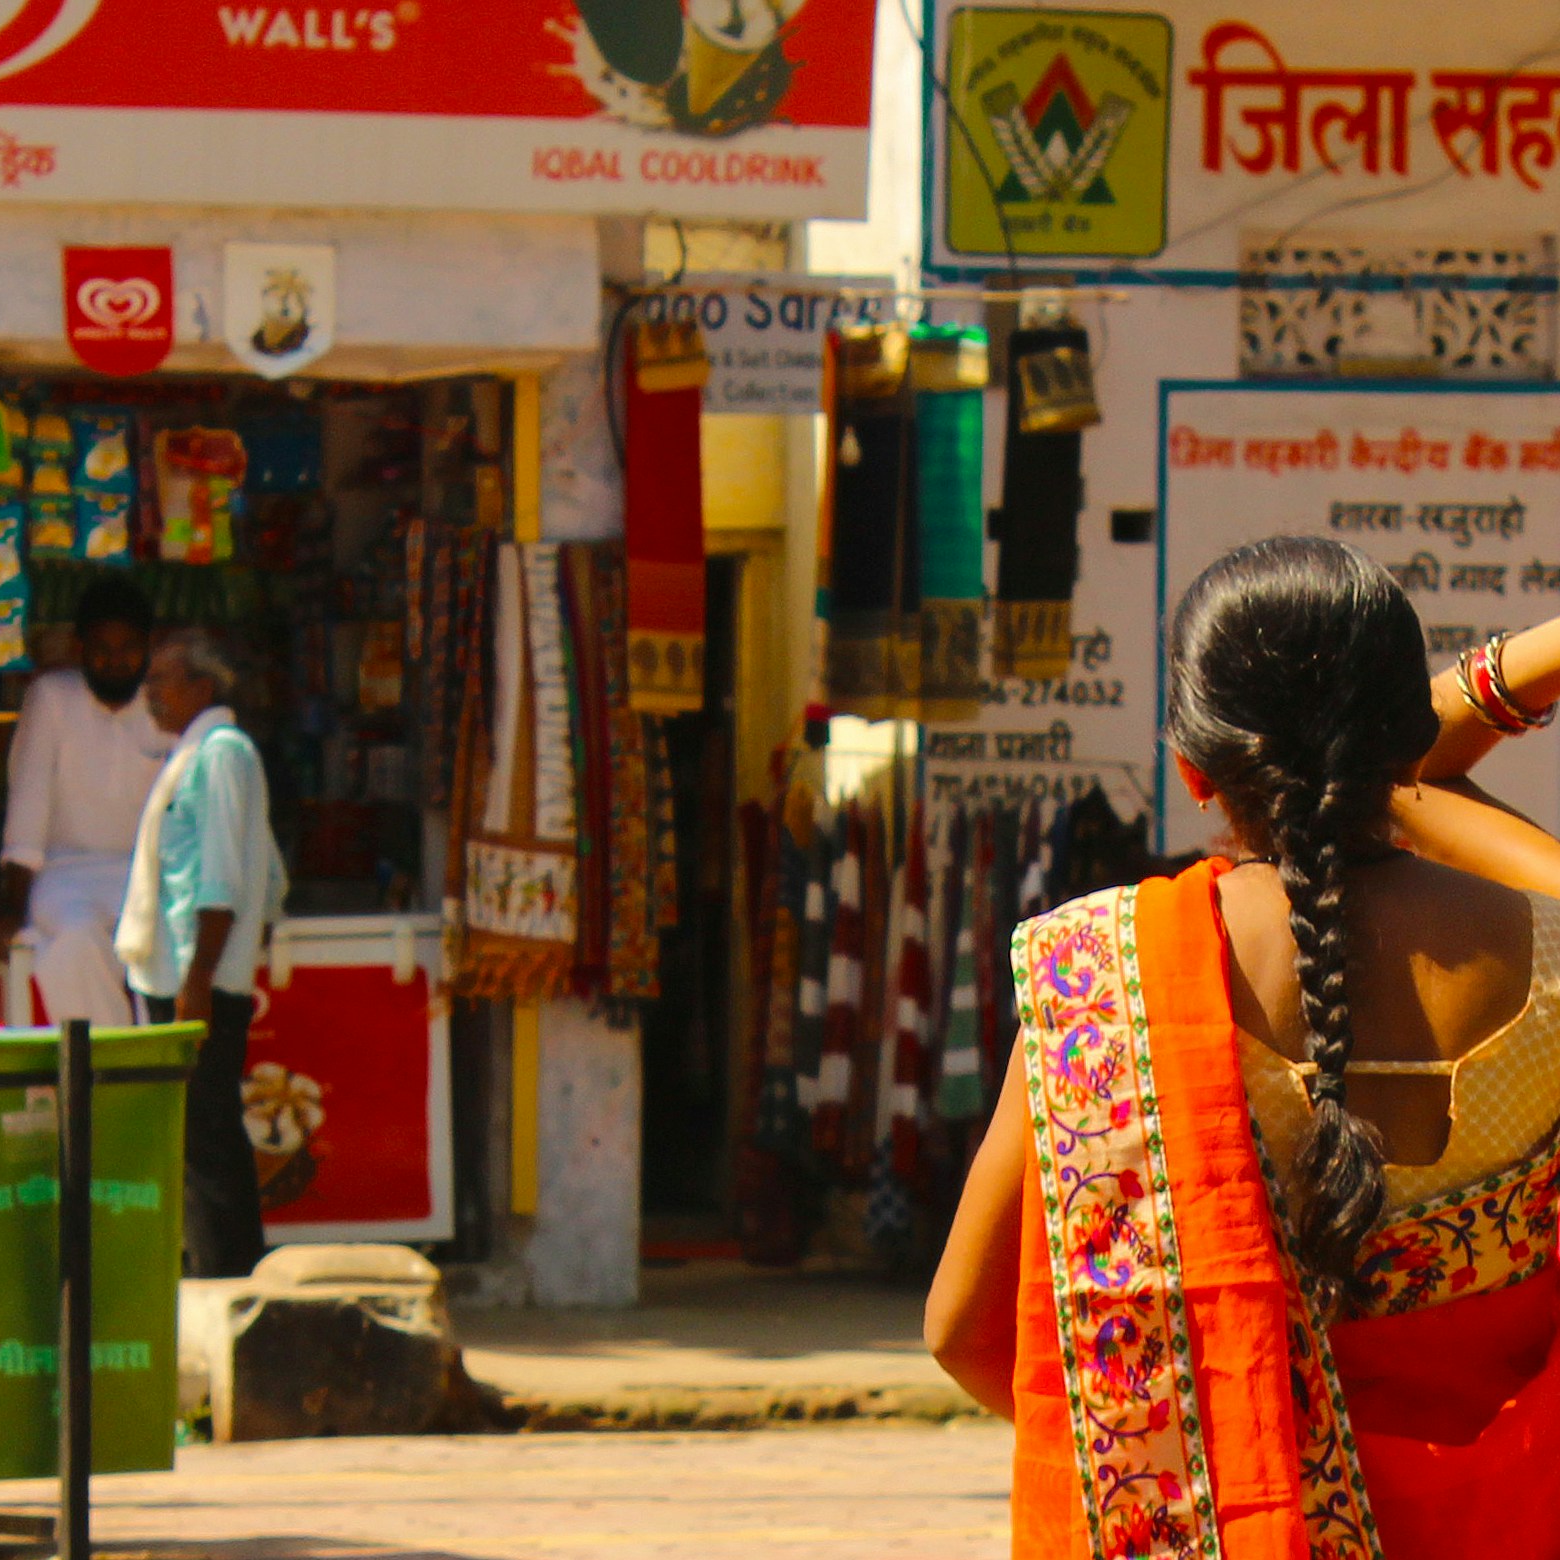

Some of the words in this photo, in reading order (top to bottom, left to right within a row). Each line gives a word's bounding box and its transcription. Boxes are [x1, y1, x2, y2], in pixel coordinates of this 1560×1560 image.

[218, 6, 395, 50] WALL'S
[1186, 20, 1416, 177] जिला
[531, 146, 624, 183] IQBAL
[640, 148, 826, 188] COOLDRINK
